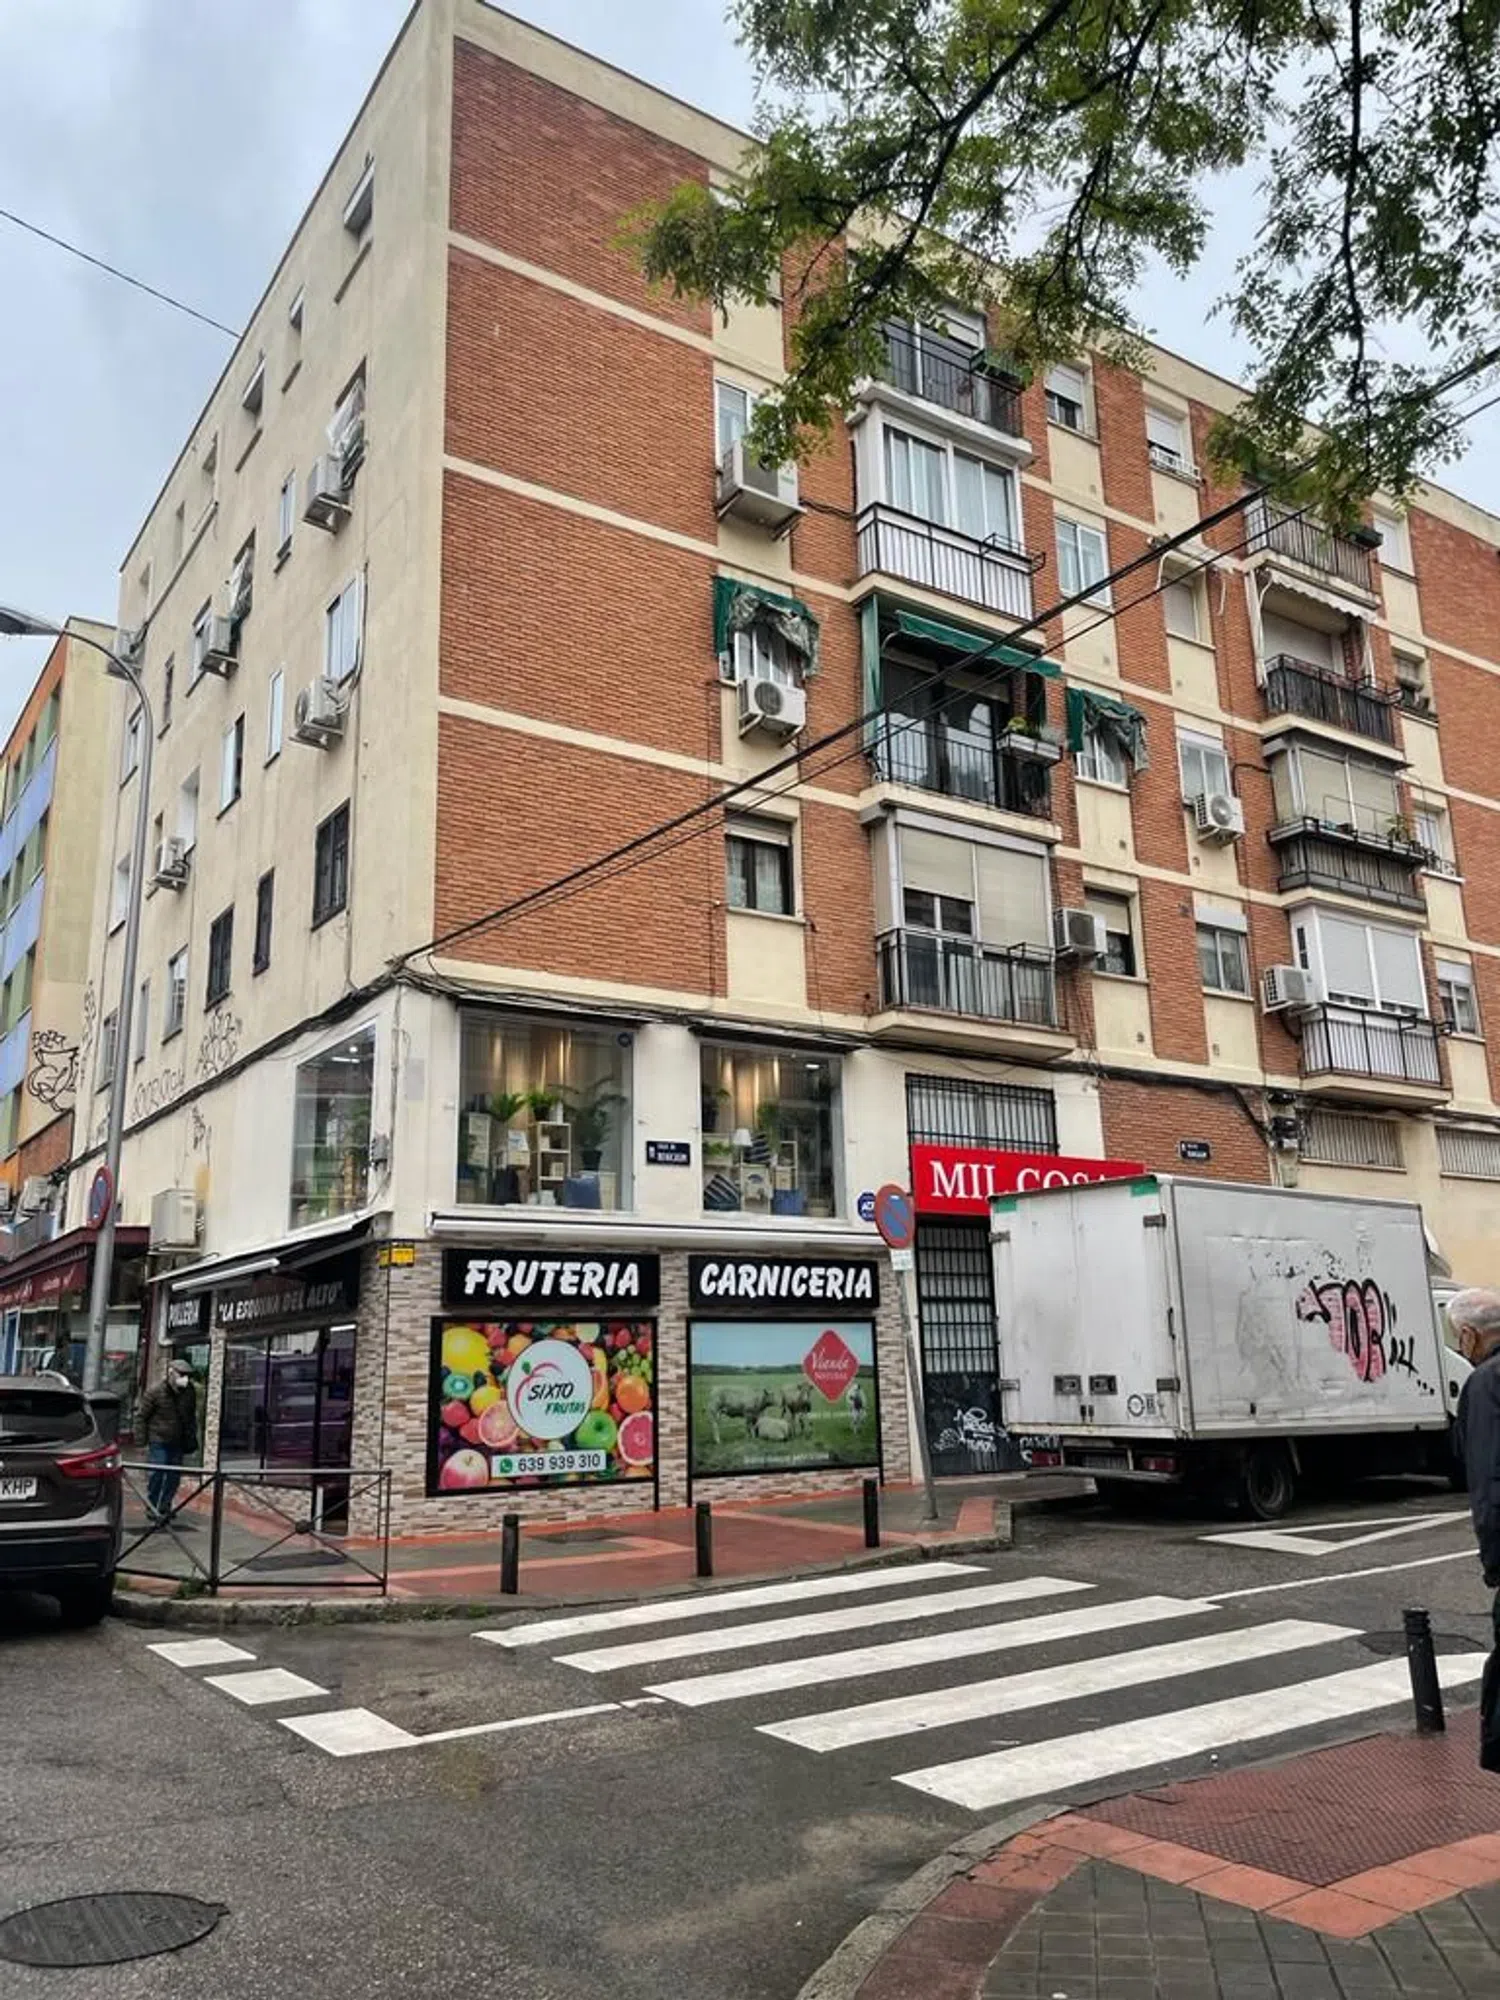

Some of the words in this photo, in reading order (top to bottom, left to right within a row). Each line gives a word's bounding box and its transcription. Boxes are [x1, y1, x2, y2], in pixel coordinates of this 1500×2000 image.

[464, 1260, 639, 1298] FRUTERIA
[700, 1263, 873, 1300] CARNICERIA
[528, 1382, 575, 1401] SIXTO
[545, 1401, 586, 1416] FRUTAS
[518, 1458, 545, 1472] 639
[549, 1456, 575, 1471] 939
[578, 1454, 601, 1469] 310
